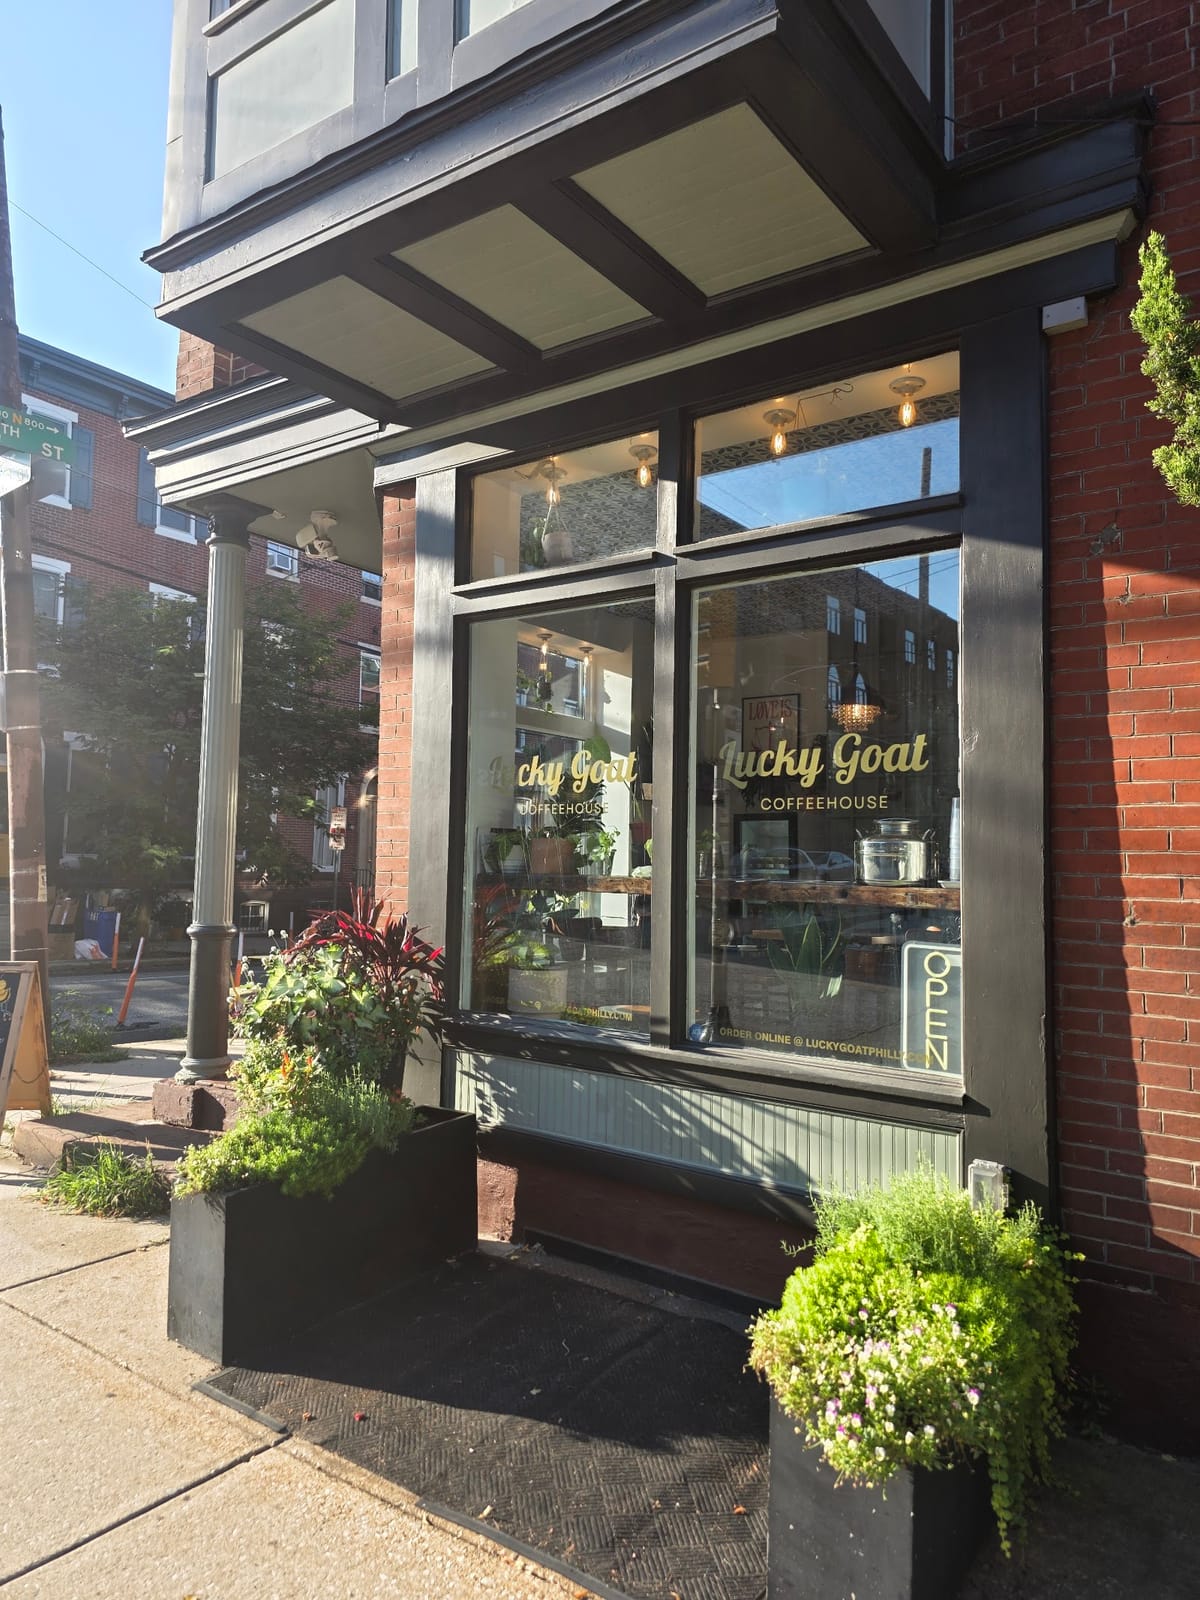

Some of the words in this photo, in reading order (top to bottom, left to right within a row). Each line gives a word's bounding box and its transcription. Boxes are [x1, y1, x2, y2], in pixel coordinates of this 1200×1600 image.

[12, 412, 23, 425] N
[24, 417, 45, 430] 800
[0, 422, 20, 438] TH
[41, 442, 65, 460] ST
[570, 749, 638, 794] Goat
[718, 738, 825, 790] Lucky
[832, 732, 929, 786] Goat
[519, 801, 609, 816] COFFEEHOUSE
[760, 795, 889, 811] COFFEEHOUSE
[922, 950, 952, 1071] OPEN
[719, 1026, 752, 1040] ORDER
[754, 1031, 792, 1045] ONLINE
[793, 1036, 804, 1047] @
